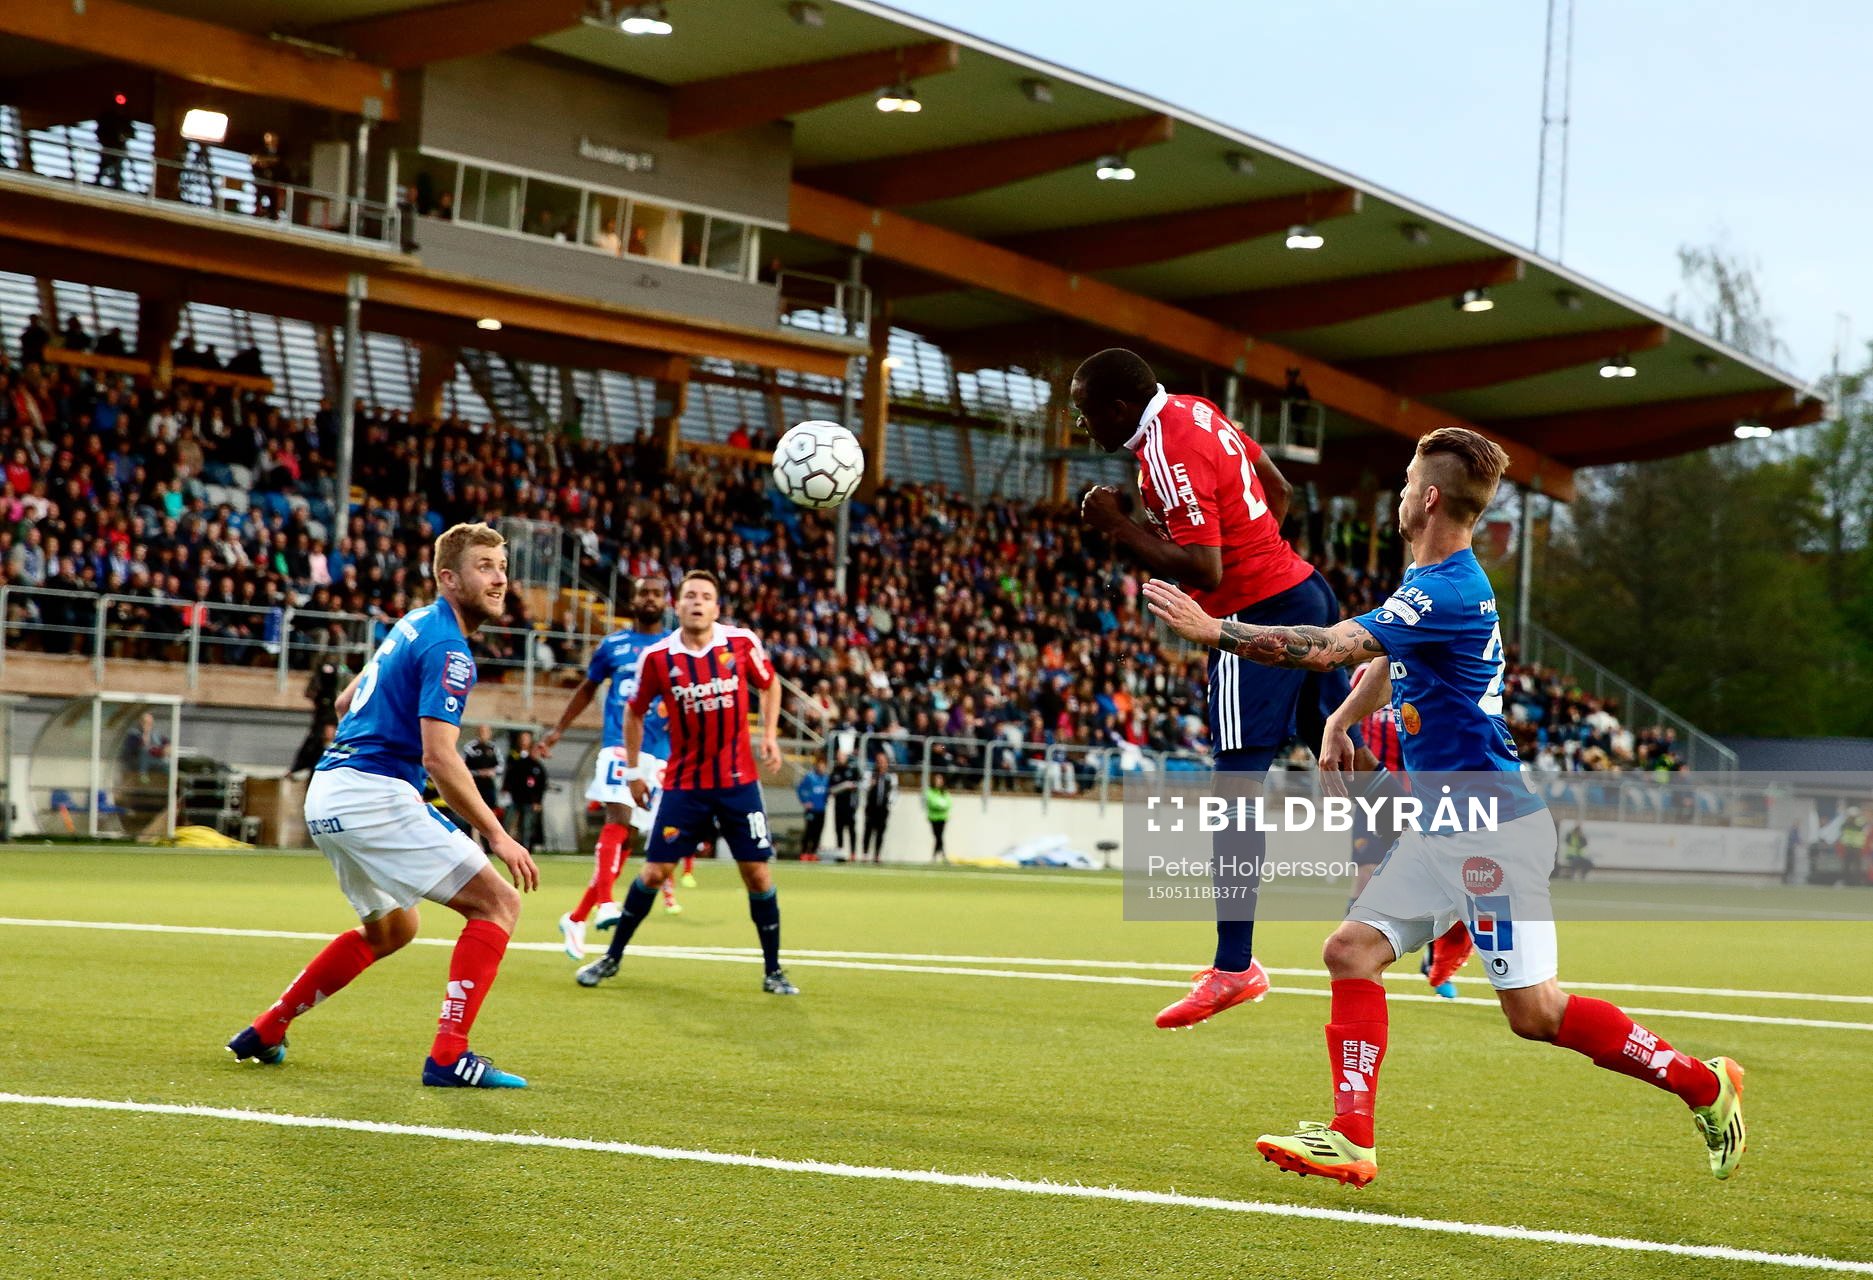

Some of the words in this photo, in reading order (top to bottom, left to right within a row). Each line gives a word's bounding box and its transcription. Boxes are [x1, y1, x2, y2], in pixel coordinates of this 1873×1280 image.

[1170, 462, 1206, 526] stadium
[1465, 866, 1496, 882] mix
[1343, 1040, 1359, 1070] INTER
[1359, 1040, 1380, 1077] SPORT
